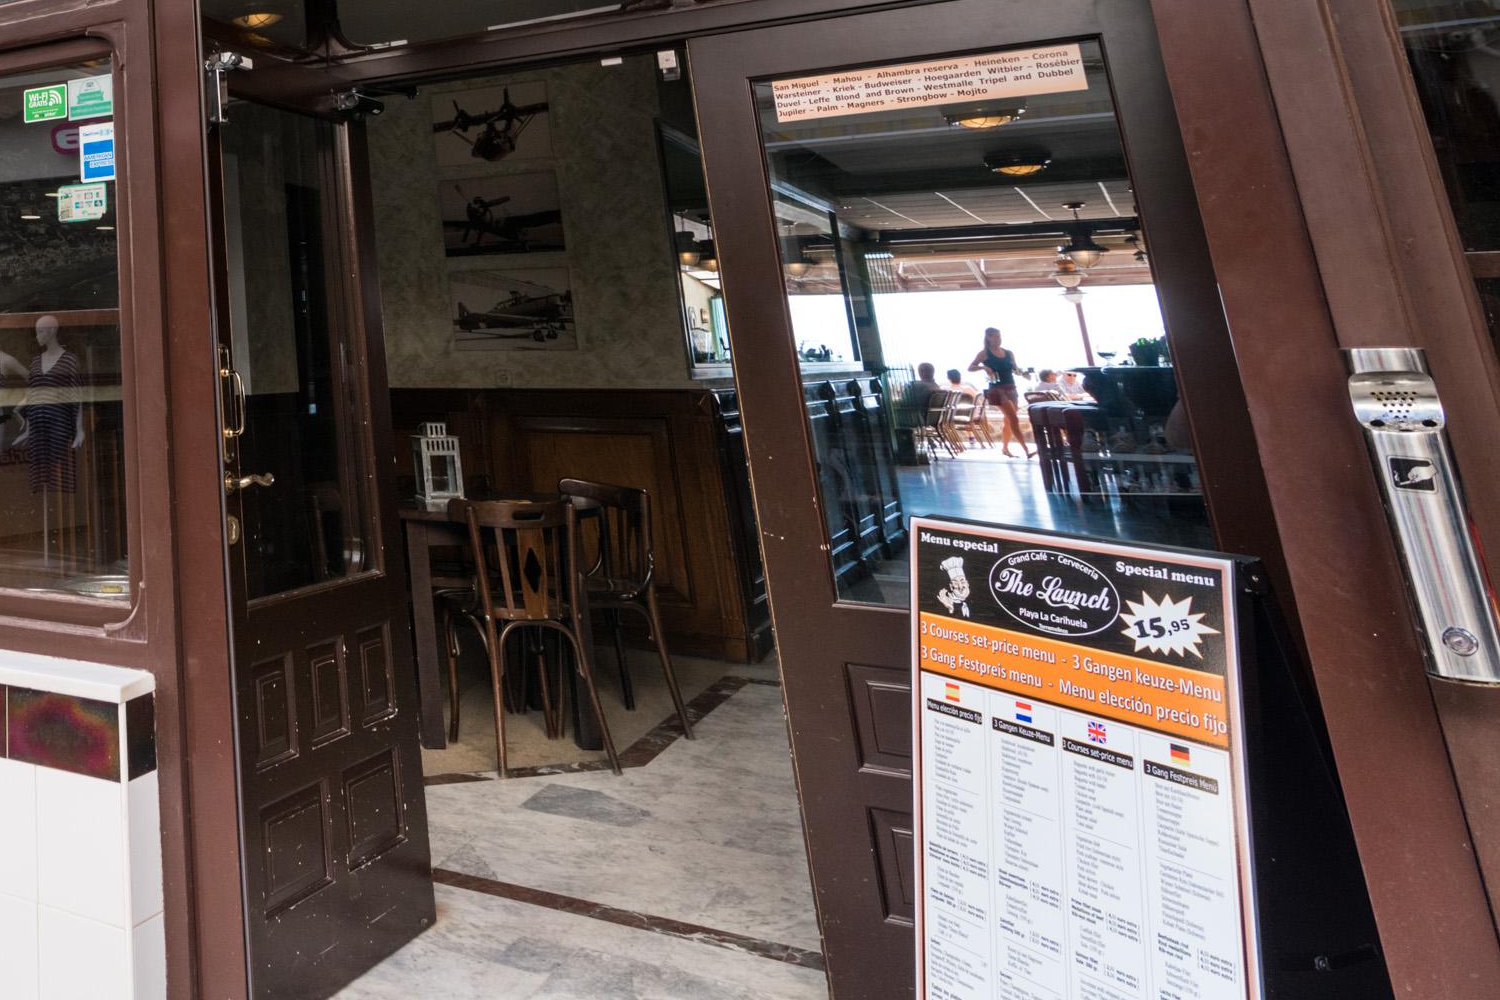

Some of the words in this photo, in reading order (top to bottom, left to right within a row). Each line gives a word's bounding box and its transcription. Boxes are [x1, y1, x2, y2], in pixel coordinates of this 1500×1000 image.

[775, 89, 822, 100] Warsteiner
[833, 84, 856, 93] Kriek
[865, 77, 912, 89] Budweiser
[924, 69, 982, 82] Hoegaarden
[987, 64, 1023, 75] Witbier
[791, 80, 819, 91] Miguel
[833, 75, 863, 85] Mahou
[877, 68, 921, 79] Alhambra
[923, 63, 959, 73] reserva
[974, 56, 1020, 67] Heineken
[1032, 50, 1069, 60] Corona
[28, 91, 49, 101] WI-FI
[777, 100, 801, 109] Duvel
[809, 96, 831, 105] Leffe
[835, 93, 860, 102] Blond
[866, 89, 882, 98] and
[885, 87, 915, 96] Brown
[923, 79, 974, 91] Westmalle
[980, 75, 1007, 86] Tripel
[1013, 72, 1032, 82] and
[1038, 67, 1074, 79] Dubbel
[28, 99, 49, 109] GRATIS
[778, 108, 807, 118] Jupiler
[817, 104, 838, 113] Palm
[847, 99, 885, 110] Magners
[897, 91, 948, 104] Strongbow
[957, 87, 988, 98] Mojito
[920, 532, 951, 546] Menu
[952, 539, 998, 554] especial
[1008, 553, 1030, 566] Grand
[1030, 551, 1048, 562] Café
[1115, 561, 1167, 580] Special
[1172, 573, 1215, 587] menu
[995, 567, 1034, 597] The
[1036, 575, 1111, 611] Launch
[1019, 607, 1039, 620] Playa
[1040, 610, 1049, 621] La
[1050, 613, 1088, 629] Carihuela
[1134, 616, 1190, 639] 15,95
[921, 622, 928, 634] 3
[930, 623, 970, 645] Courses
[972, 635, 1019, 655] set-price
[1022, 646, 1056, 664] menu
[1073, 654, 1081, 669] 3
[1084, 657, 1132, 682] Gangen
[1135, 667, 1221, 702] keuze-Menu
[921, 646, 928, 659] 3
[930, 648, 957, 669] Gang
[959, 654, 1007, 679] Festpreis
[1009, 670, 1043, 688] menu
[1059, 679, 1095, 701] Menu
[1098, 689, 1153, 716] elección
[1156, 705, 1200, 727] precio
[1203, 712, 1227, 736] fijo
[994, 719, 999, 727] 3
[999, 720, 1018, 734] Gangen
[1067, 741, 1090, 757] Courses
[1090, 748, 1116, 763] set-price
[1117, 756, 1133, 768] menu
[1146, 764, 1151, 773] 3
[1152, 765, 1169, 780] Gang
[1169, 770, 1199, 787] Festpreis
